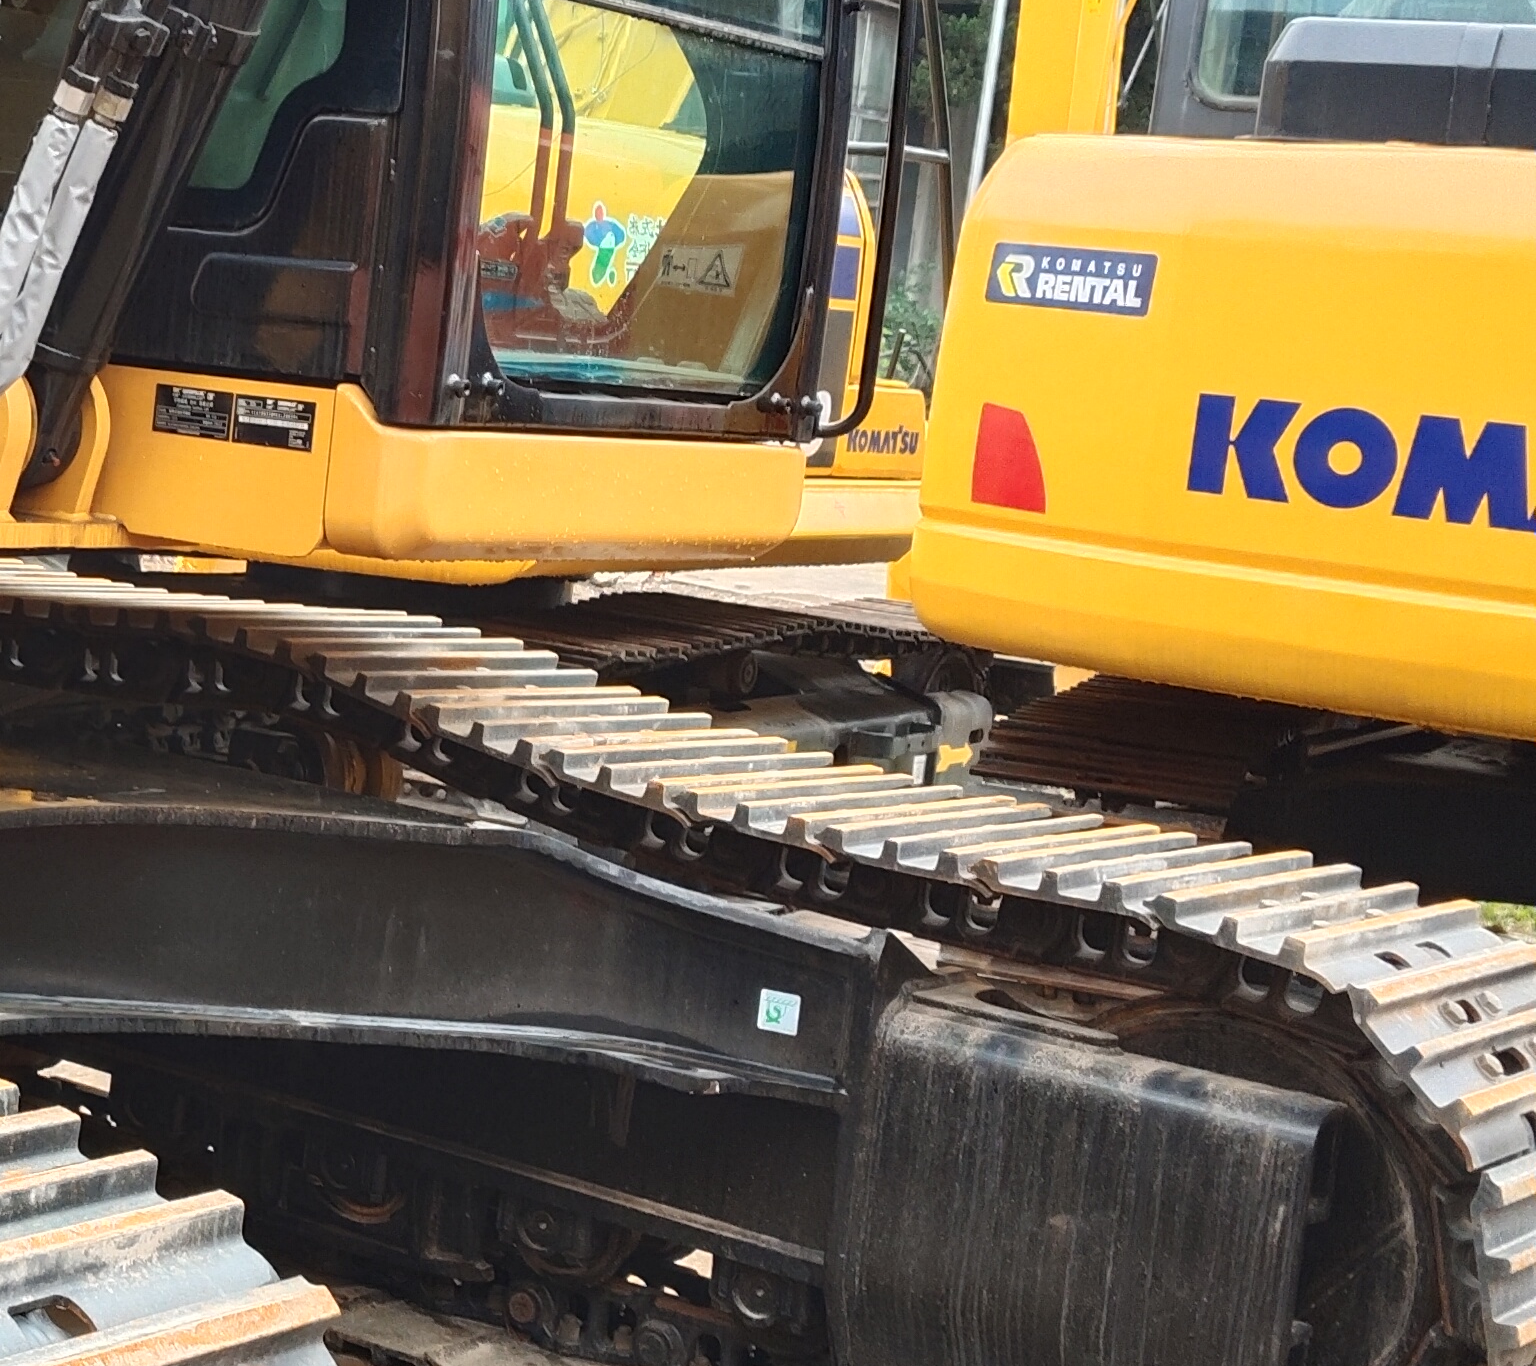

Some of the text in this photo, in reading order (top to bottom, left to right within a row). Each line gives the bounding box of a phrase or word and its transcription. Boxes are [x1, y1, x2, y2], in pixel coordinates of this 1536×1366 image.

[1041, 256, 1143, 277] KOMATSU
[1035, 272, 1143, 308] RENTAL
[846, 424, 920, 455] KOMATSU
[1187, 393, 1536, 533] KOM
